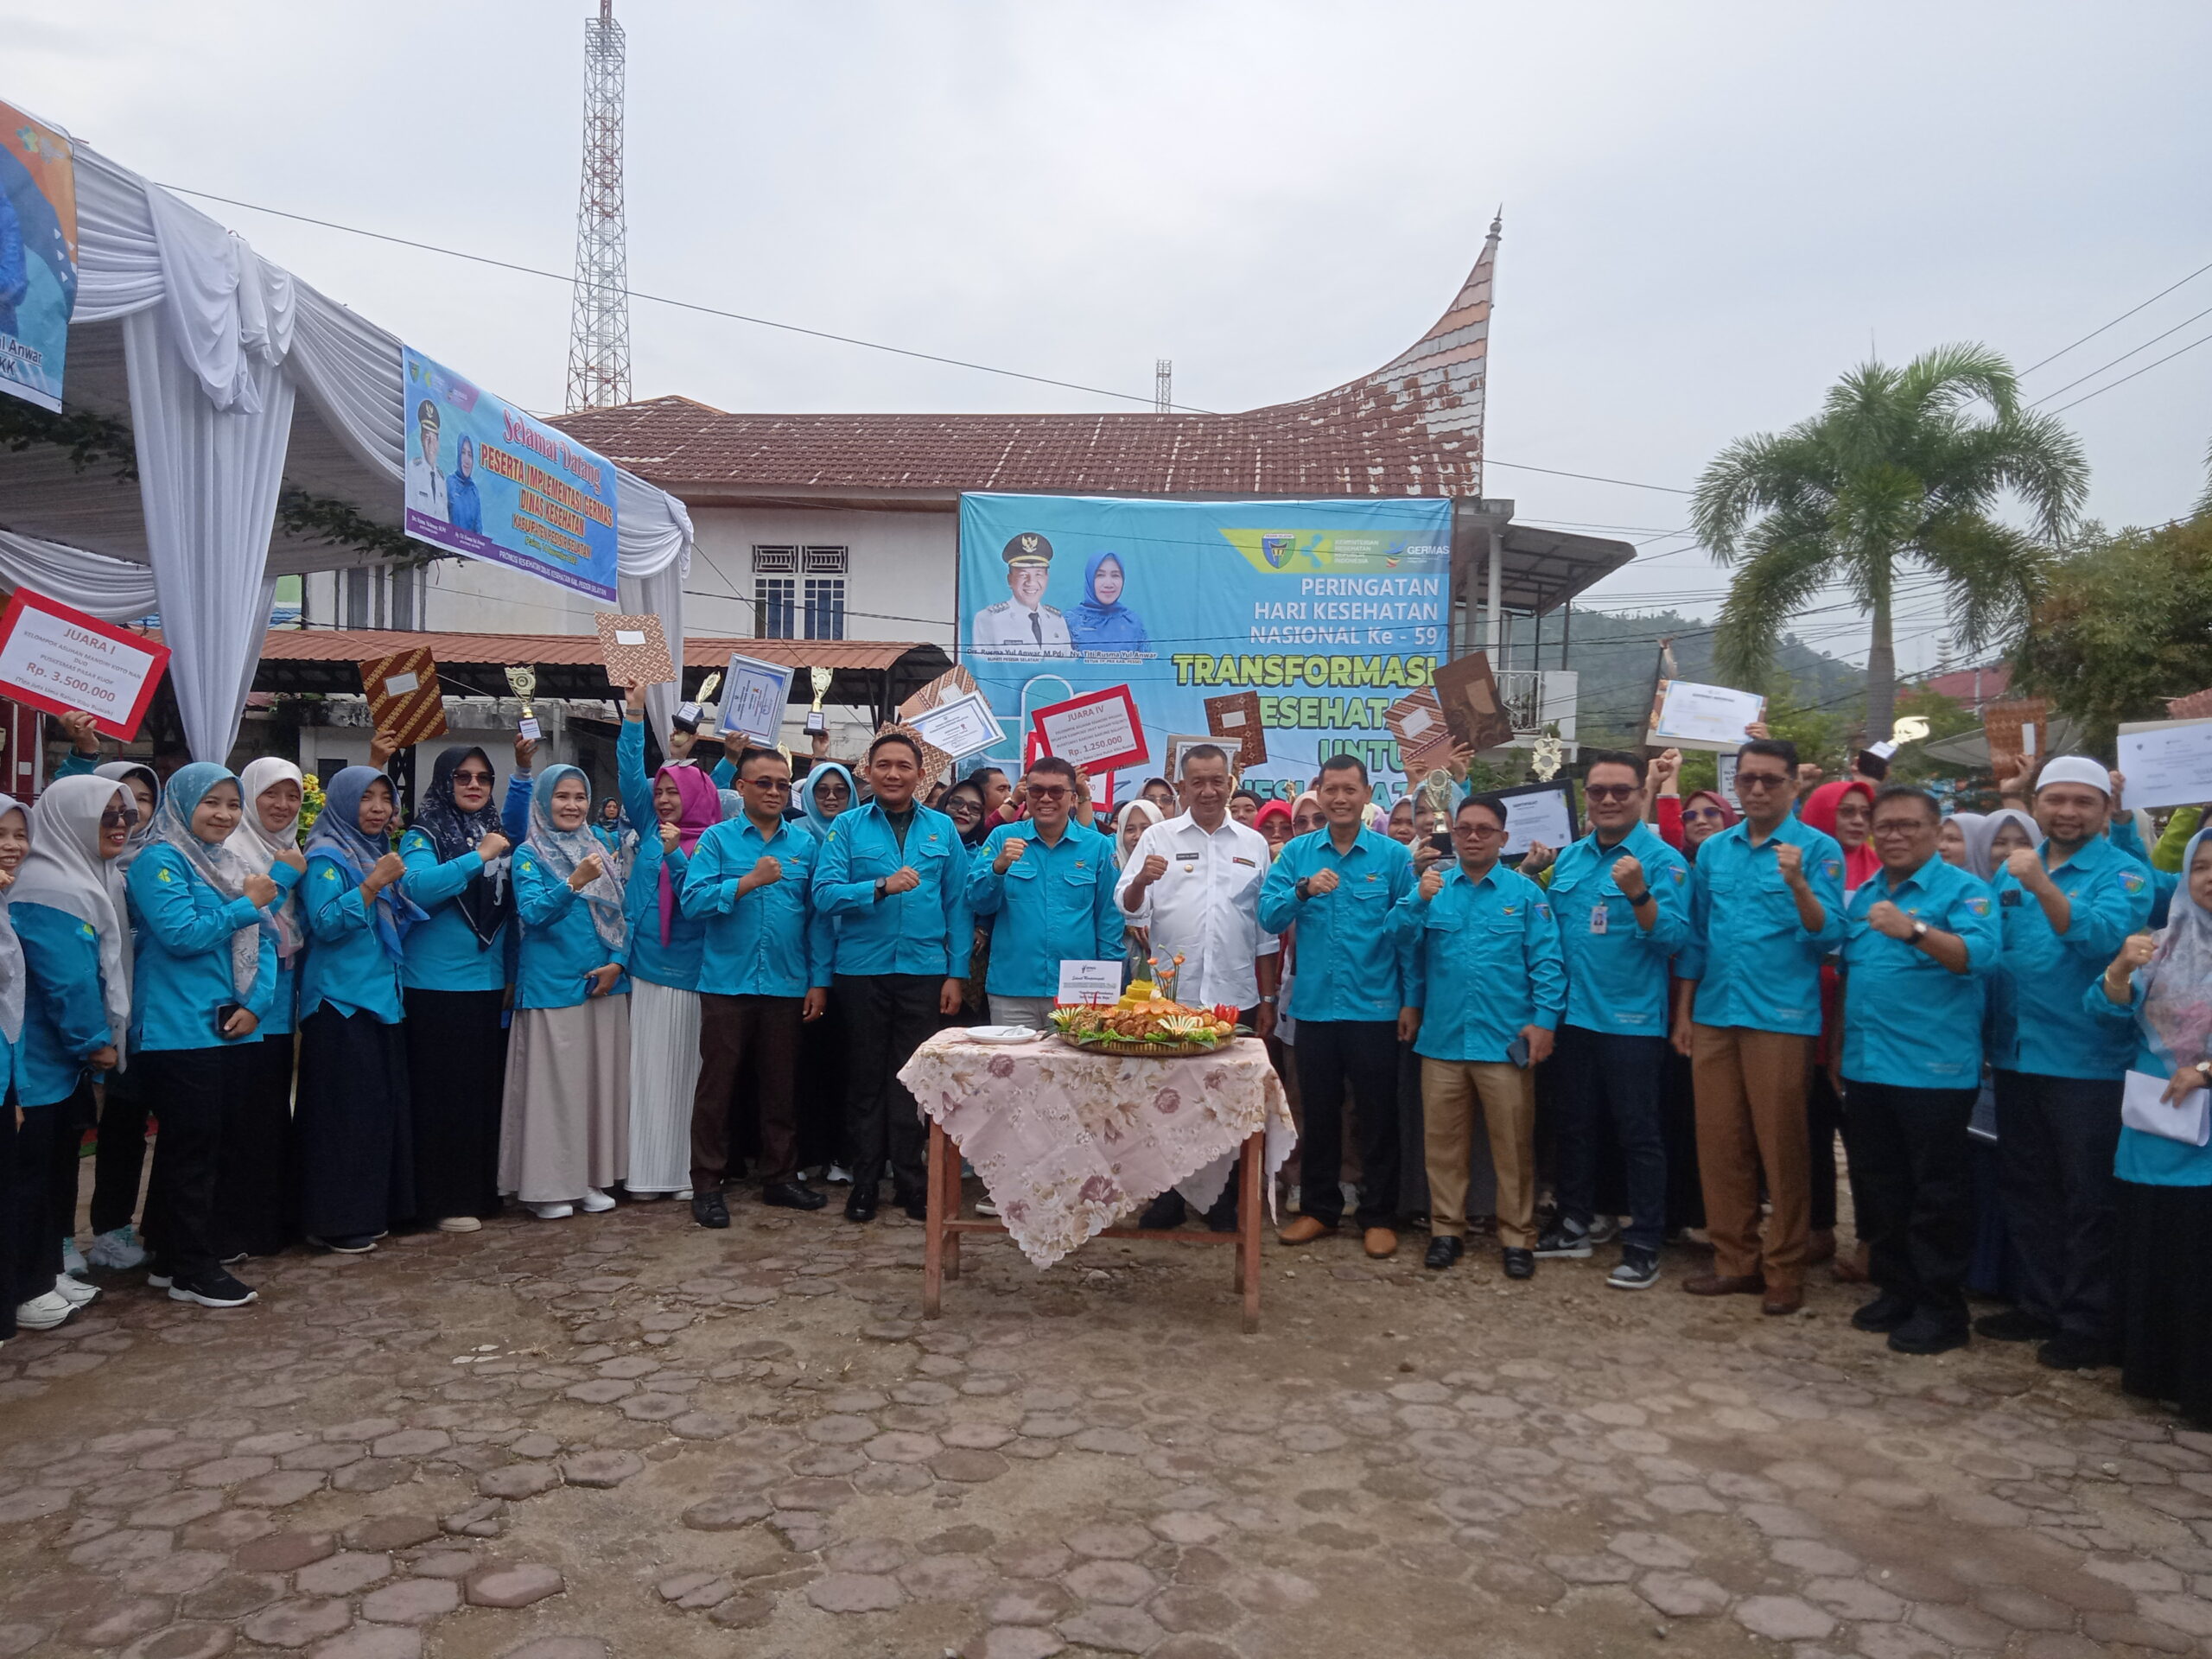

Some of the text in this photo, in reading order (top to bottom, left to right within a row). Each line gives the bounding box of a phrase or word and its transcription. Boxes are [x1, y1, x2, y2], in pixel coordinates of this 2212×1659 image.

[9, 339, 42, 364] Anwar
[503, 408, 601, 495] Selamat Datang
[480, 442, 613, 528] PESERTA IMPLEMENTASI GERMAS
[520, 488, 585, 537] DINAS KESEHATAN
[512, 513, 547, 540] KABUPATEN
[569, 537, 591, 559] SELATAN
[1407, 545, 1450, 555] GERMAS
[1301, 578, 1439, 596] PERINGATAN
[1255, 602, 1438, 620] HARI KESEHATAN
[62, 627, 116, 655] JUARA I
[1250, 626, 1360, 645] NASIONAL
[1368, 626, 1393, 645] Ke
[1414, 627, 1438, 645] 59
[23, 631, 57, 647] KELOMPOK
[57, 644, 83, 657] ASUHAN
[111, 664, 127, 674] KOTO
[25, 662, 116, 702] Rp. 3.500.000
[1172, 653, 1437, 688] TRANSFORMASI
[1066, 708, 1094, 721] JUARA
[1258, 696, 1402, 729] ESEHAT
[1067, 747, 1082, 757] Rp.
[1083, 734, 1122, 753] 1.250.000
